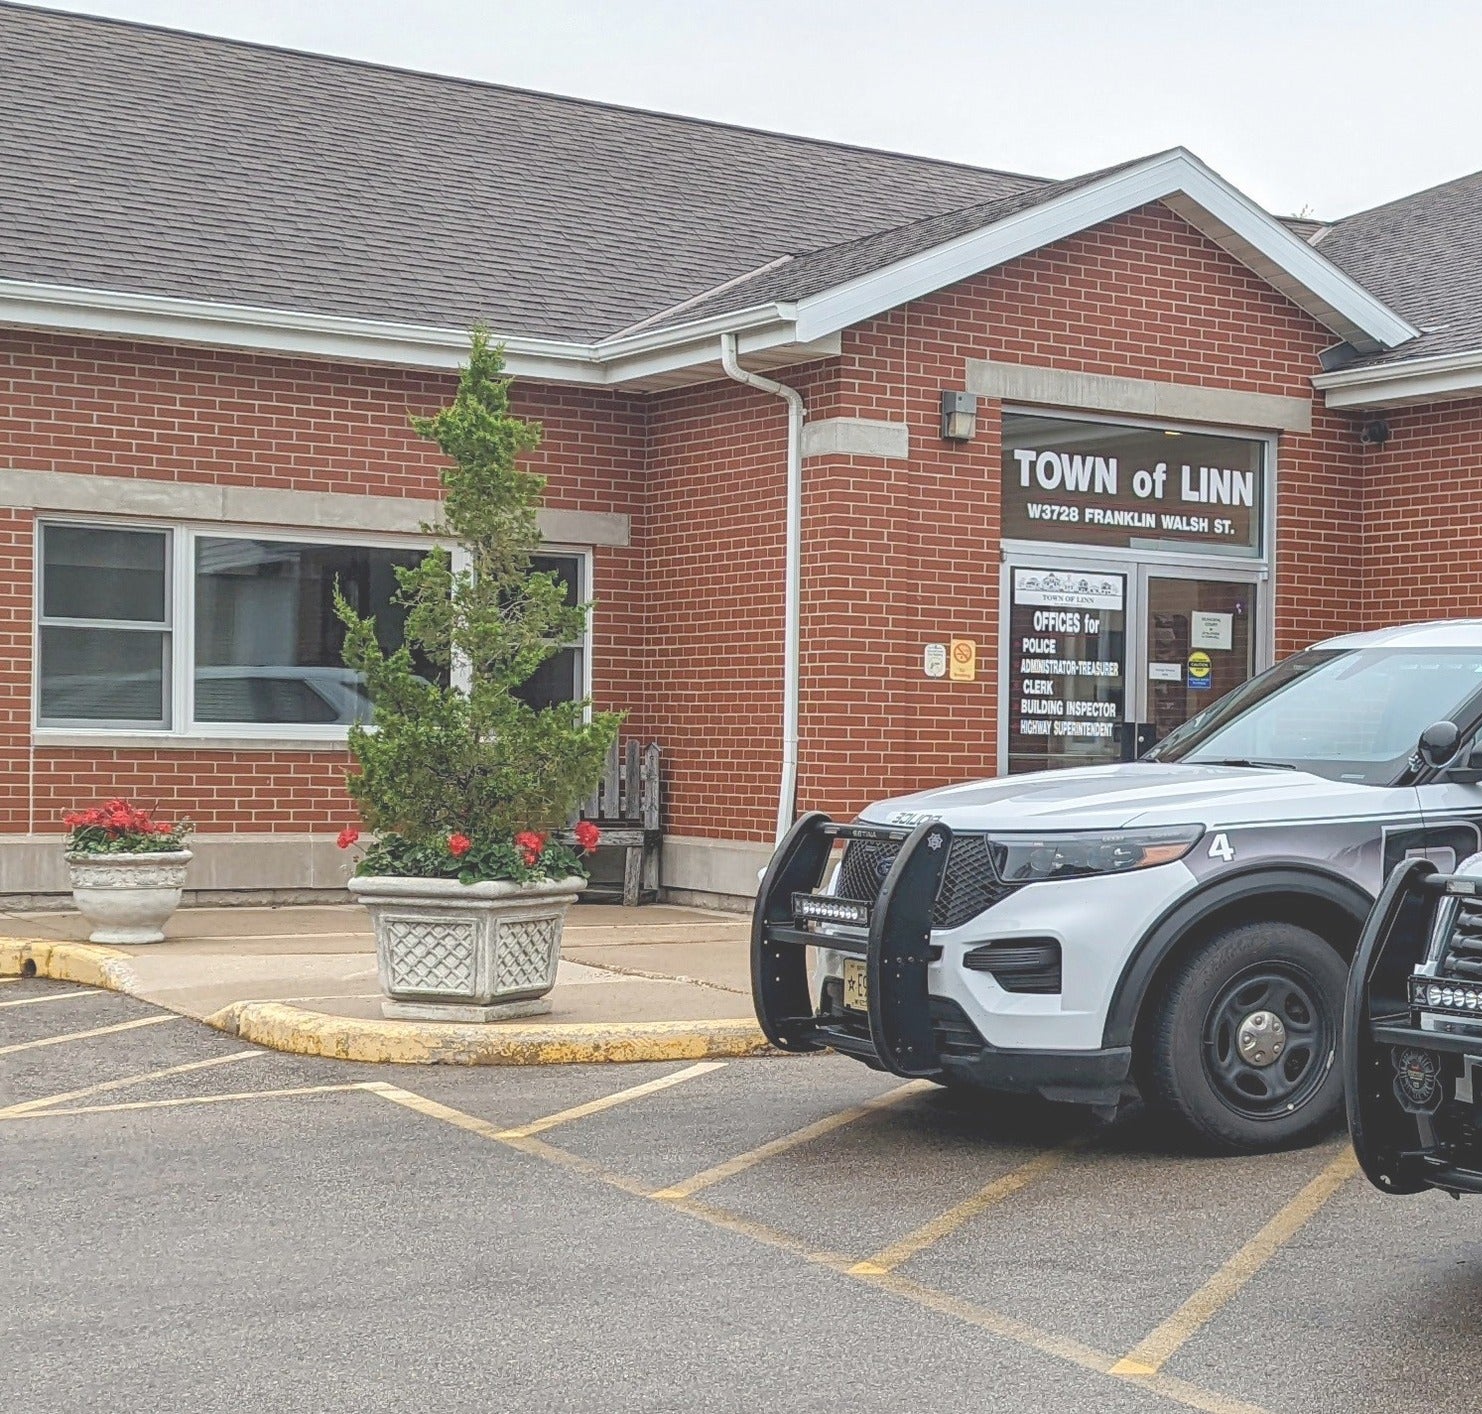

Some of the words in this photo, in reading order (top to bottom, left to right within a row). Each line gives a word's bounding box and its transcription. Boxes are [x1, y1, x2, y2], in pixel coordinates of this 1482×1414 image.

[1013, 449, 1118, 495] TOWN
[1132, 463, 1167, 499] of
[1181, 465, 1254, 507] LINN
[1027, 503, 1079, 523] W3728
[1085, 508, 1156, 529] FRANKLIN
[1161, 514, 1209, 533] WALSH
[1214, 519, 1235, 535] ST.
[1042, 594, 1064, 602] TOWN
[1076, 596, 1095, 604] LINN
[1033, 610, 1081, 633] OFFICES
[1084, 613, 1101, 634] for
[1022, 637, 1056, 654] POLICE
[1020, 658, 1119, 677] ADMINISTRATOR-TREASURER
[1023, 679, 1054, 695] CLERK
[1020, 698, 1064, 716] BUILDING
[1066, 700, 1116, 718] INSPECTOR
[1020, 719, 1052, 735] HIGHWAY
[1053, 720, 1114, 737] SUPERINTENDENT
[1207, 832, 1235, 863] 4
